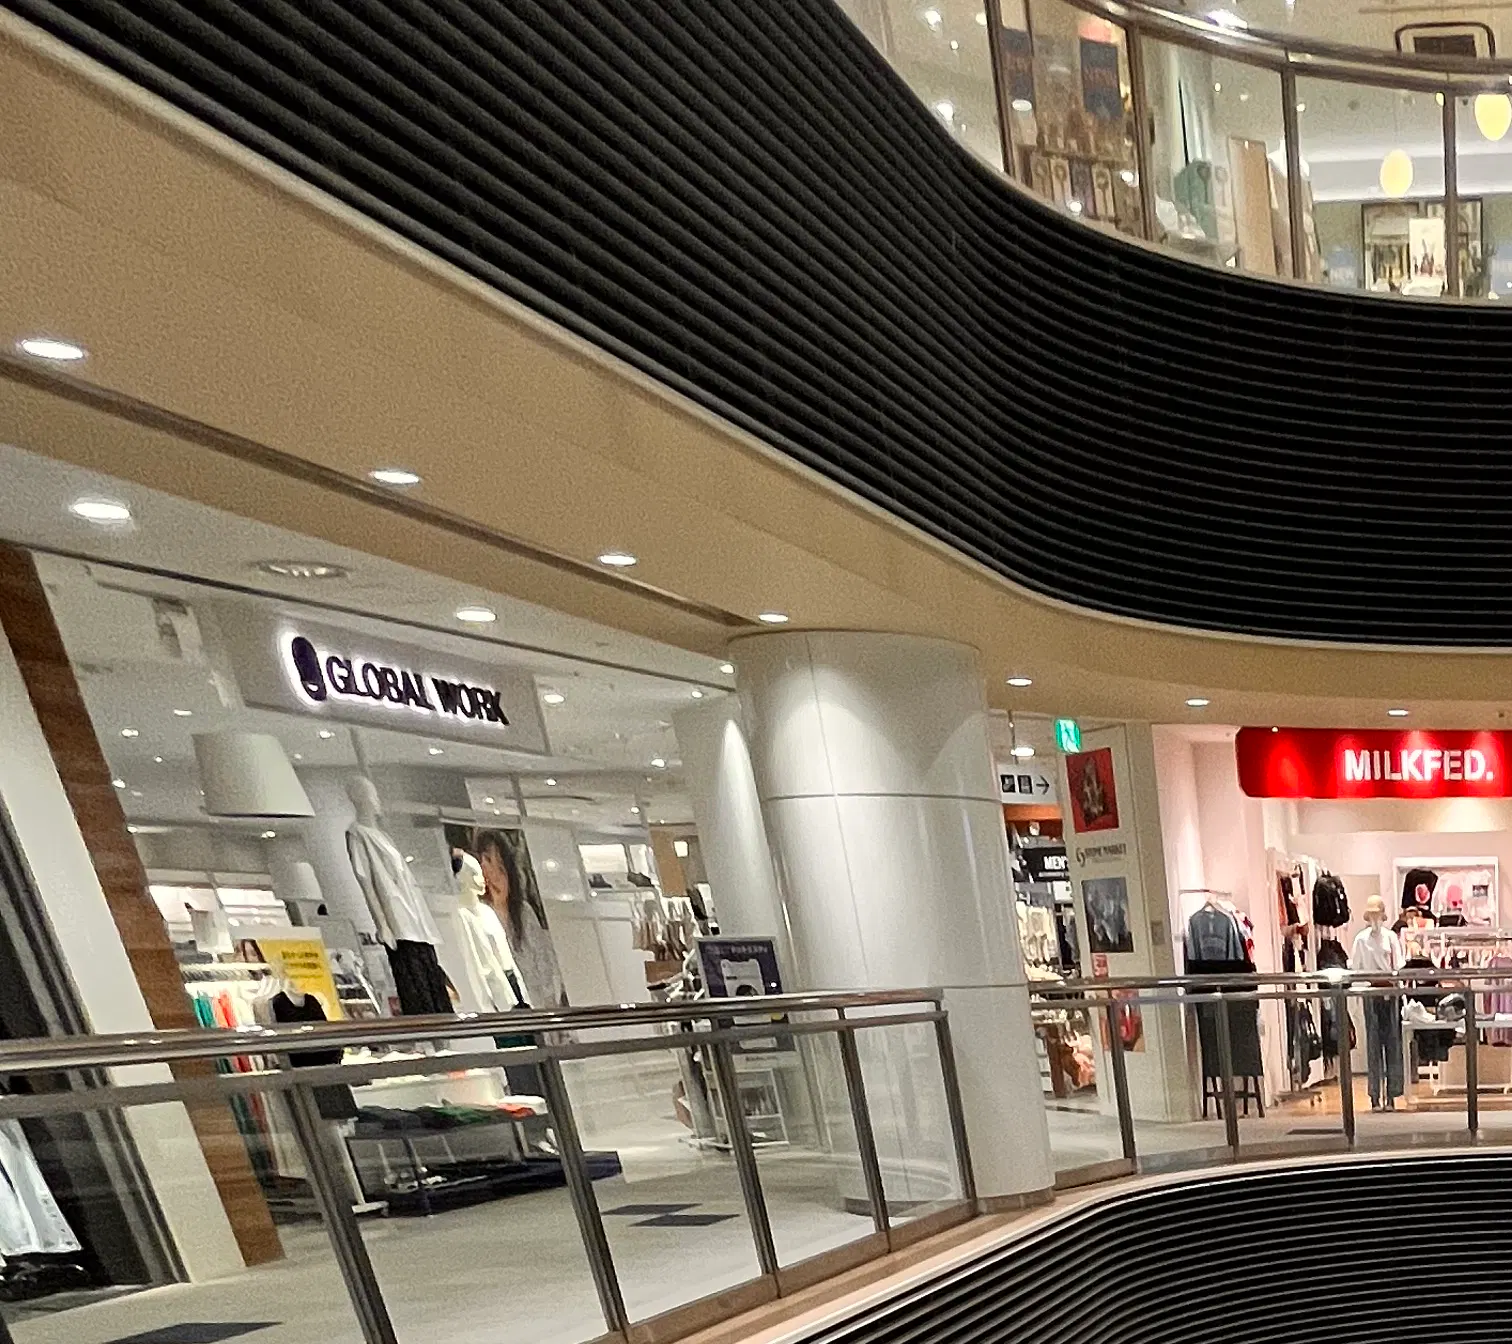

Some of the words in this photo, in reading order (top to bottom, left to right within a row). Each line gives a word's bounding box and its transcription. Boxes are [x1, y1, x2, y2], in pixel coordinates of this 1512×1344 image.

[326, 655, 435, 711] GLOBAL
[431, 677, 511, 727] WORK
[1343, 749, 1495, 782] MILKFED.
